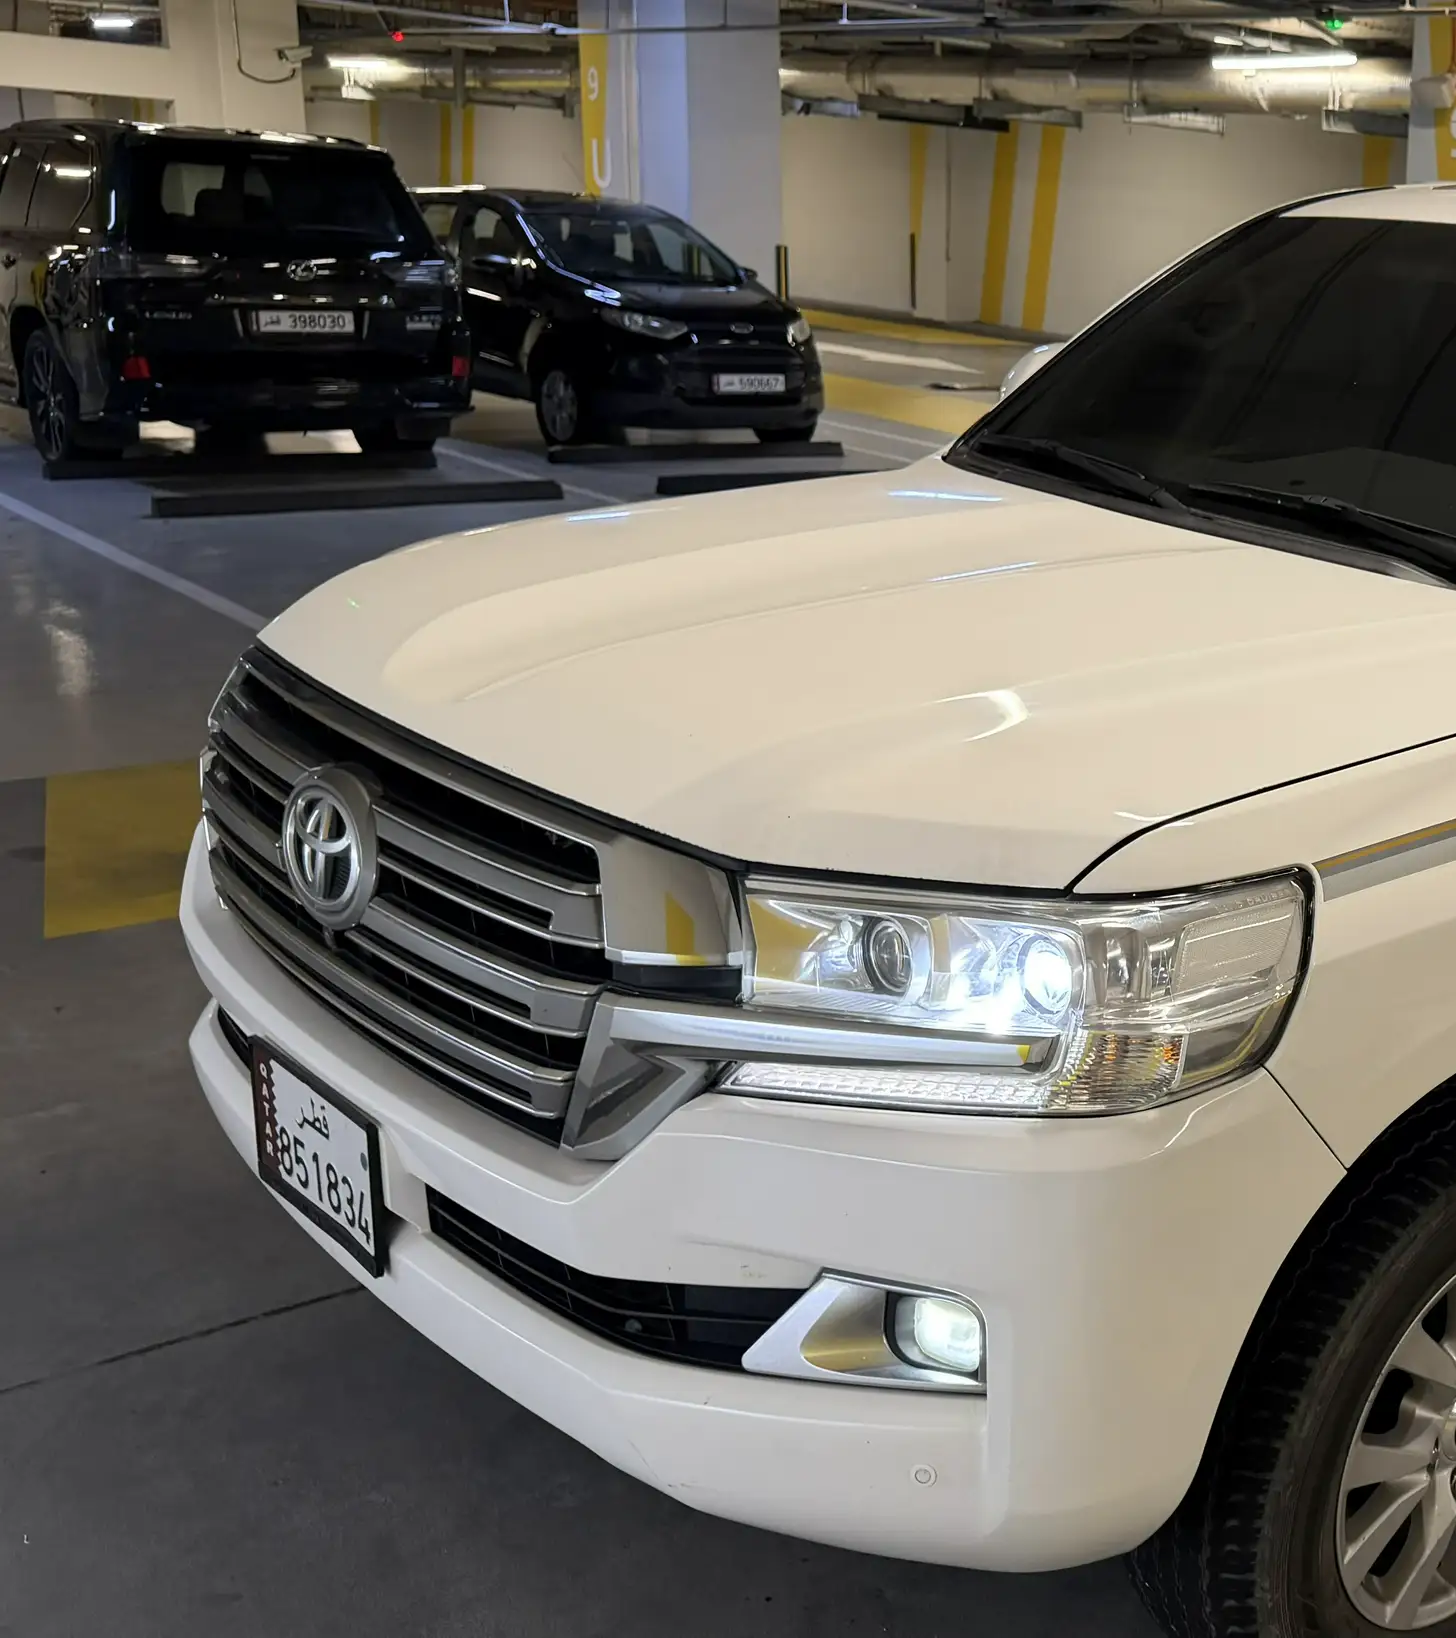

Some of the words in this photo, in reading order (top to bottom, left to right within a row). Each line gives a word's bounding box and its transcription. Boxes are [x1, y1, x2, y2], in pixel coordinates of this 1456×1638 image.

[587, 67, 599, 101] 9
[592, 138, 612, 188] U
[288, 313, 346, 330] 398030
[259, 1062, 275, 1157] QATAR
[296, 1097, 330, 1141] قطر
[278, 1126, 371, 1245] 851834
